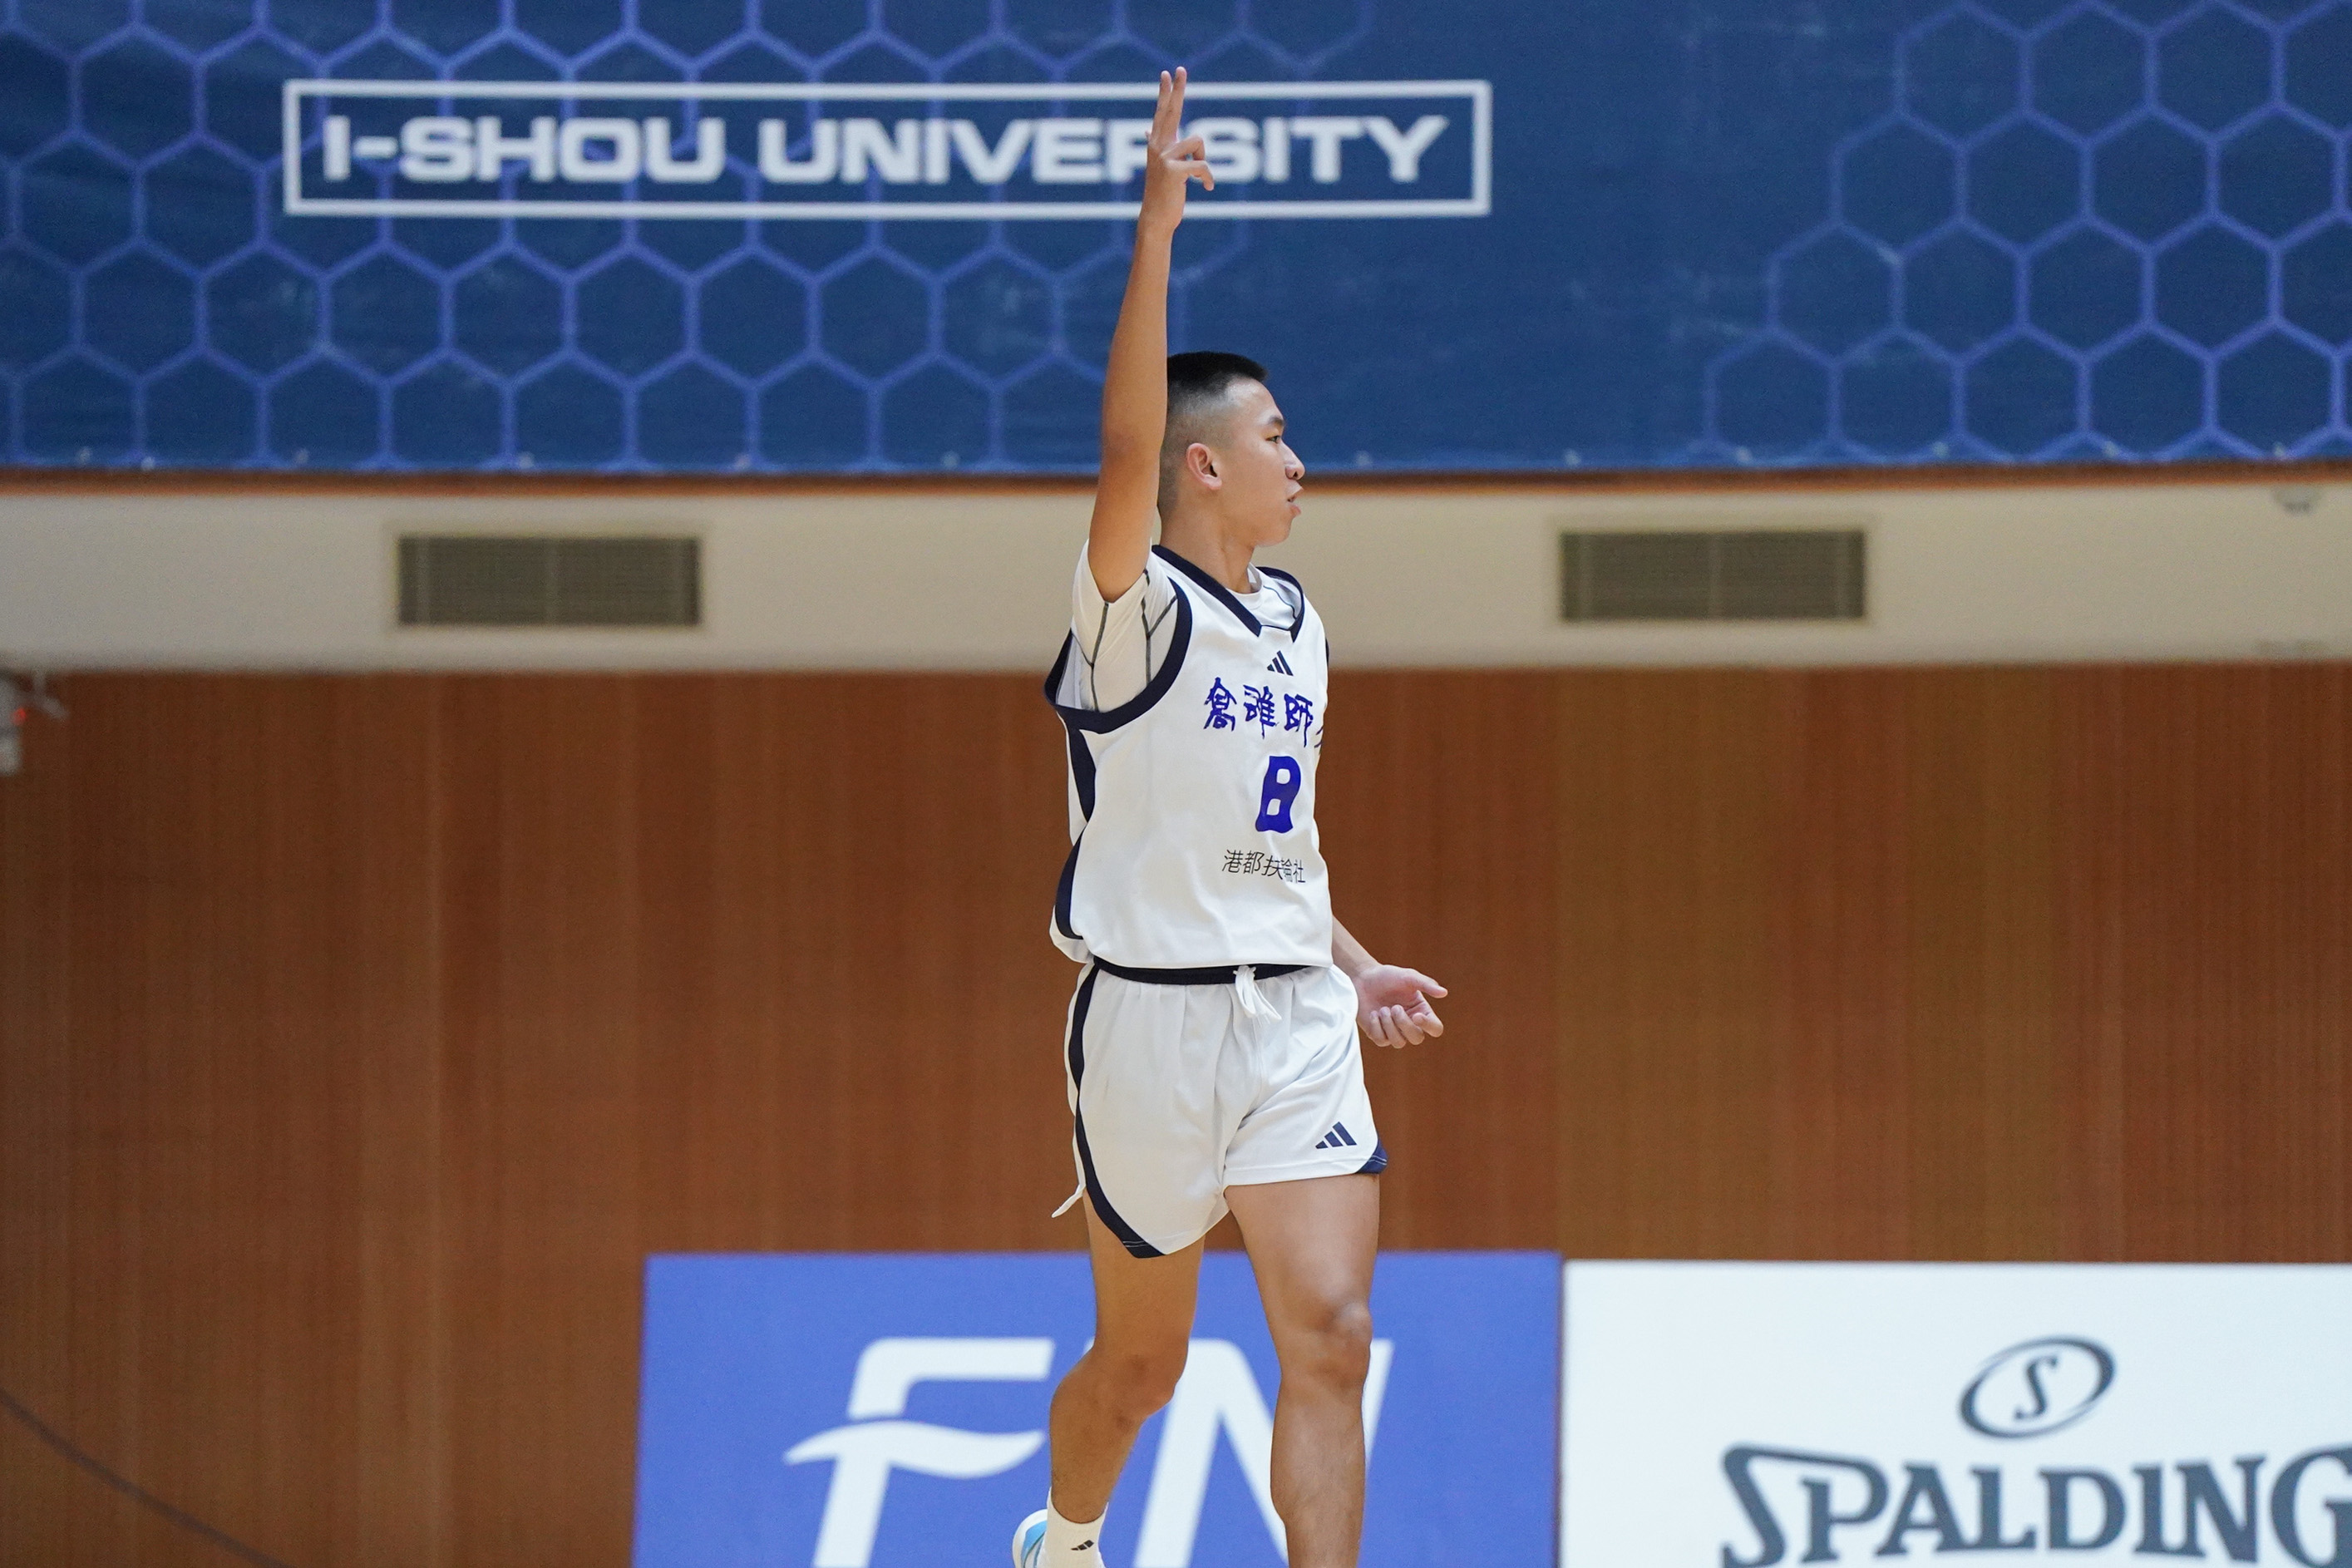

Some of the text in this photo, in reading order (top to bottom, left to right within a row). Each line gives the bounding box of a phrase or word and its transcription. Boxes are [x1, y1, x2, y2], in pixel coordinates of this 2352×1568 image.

[323, 115, 727, 183] I-SHOU
[1255, 755, 1302, 834] 8
[1720, 1442, 2352, 1568] SPALDING
